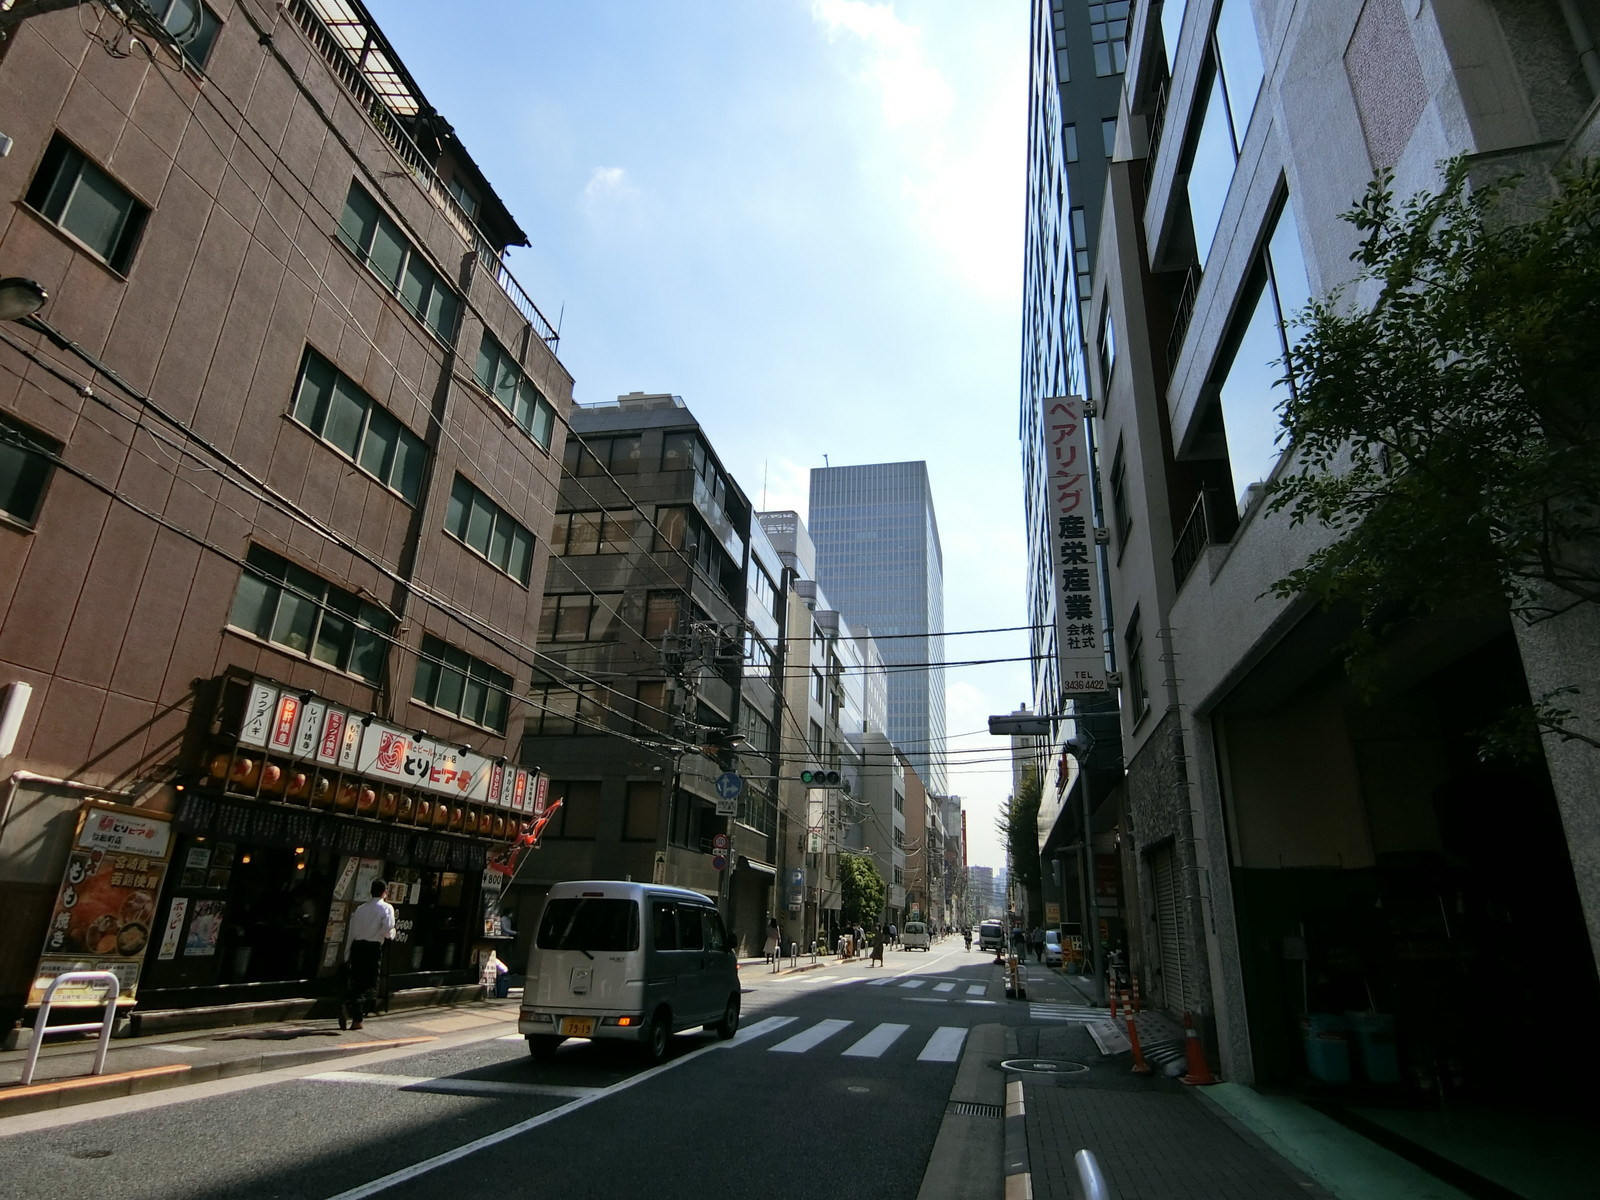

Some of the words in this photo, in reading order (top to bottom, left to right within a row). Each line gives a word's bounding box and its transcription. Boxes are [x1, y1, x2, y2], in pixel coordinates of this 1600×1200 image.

[1048, 402, 1084, 513] ベアリング
[1058, 514, 1094, 621] 産栄産業
[1074, 672, 1093, 680] TEL
[302, 708, 318, 750] レバー焼き
[324, 715, 341, 757] ミックス焼き
[344, 725, 356, 760] もも焼き
